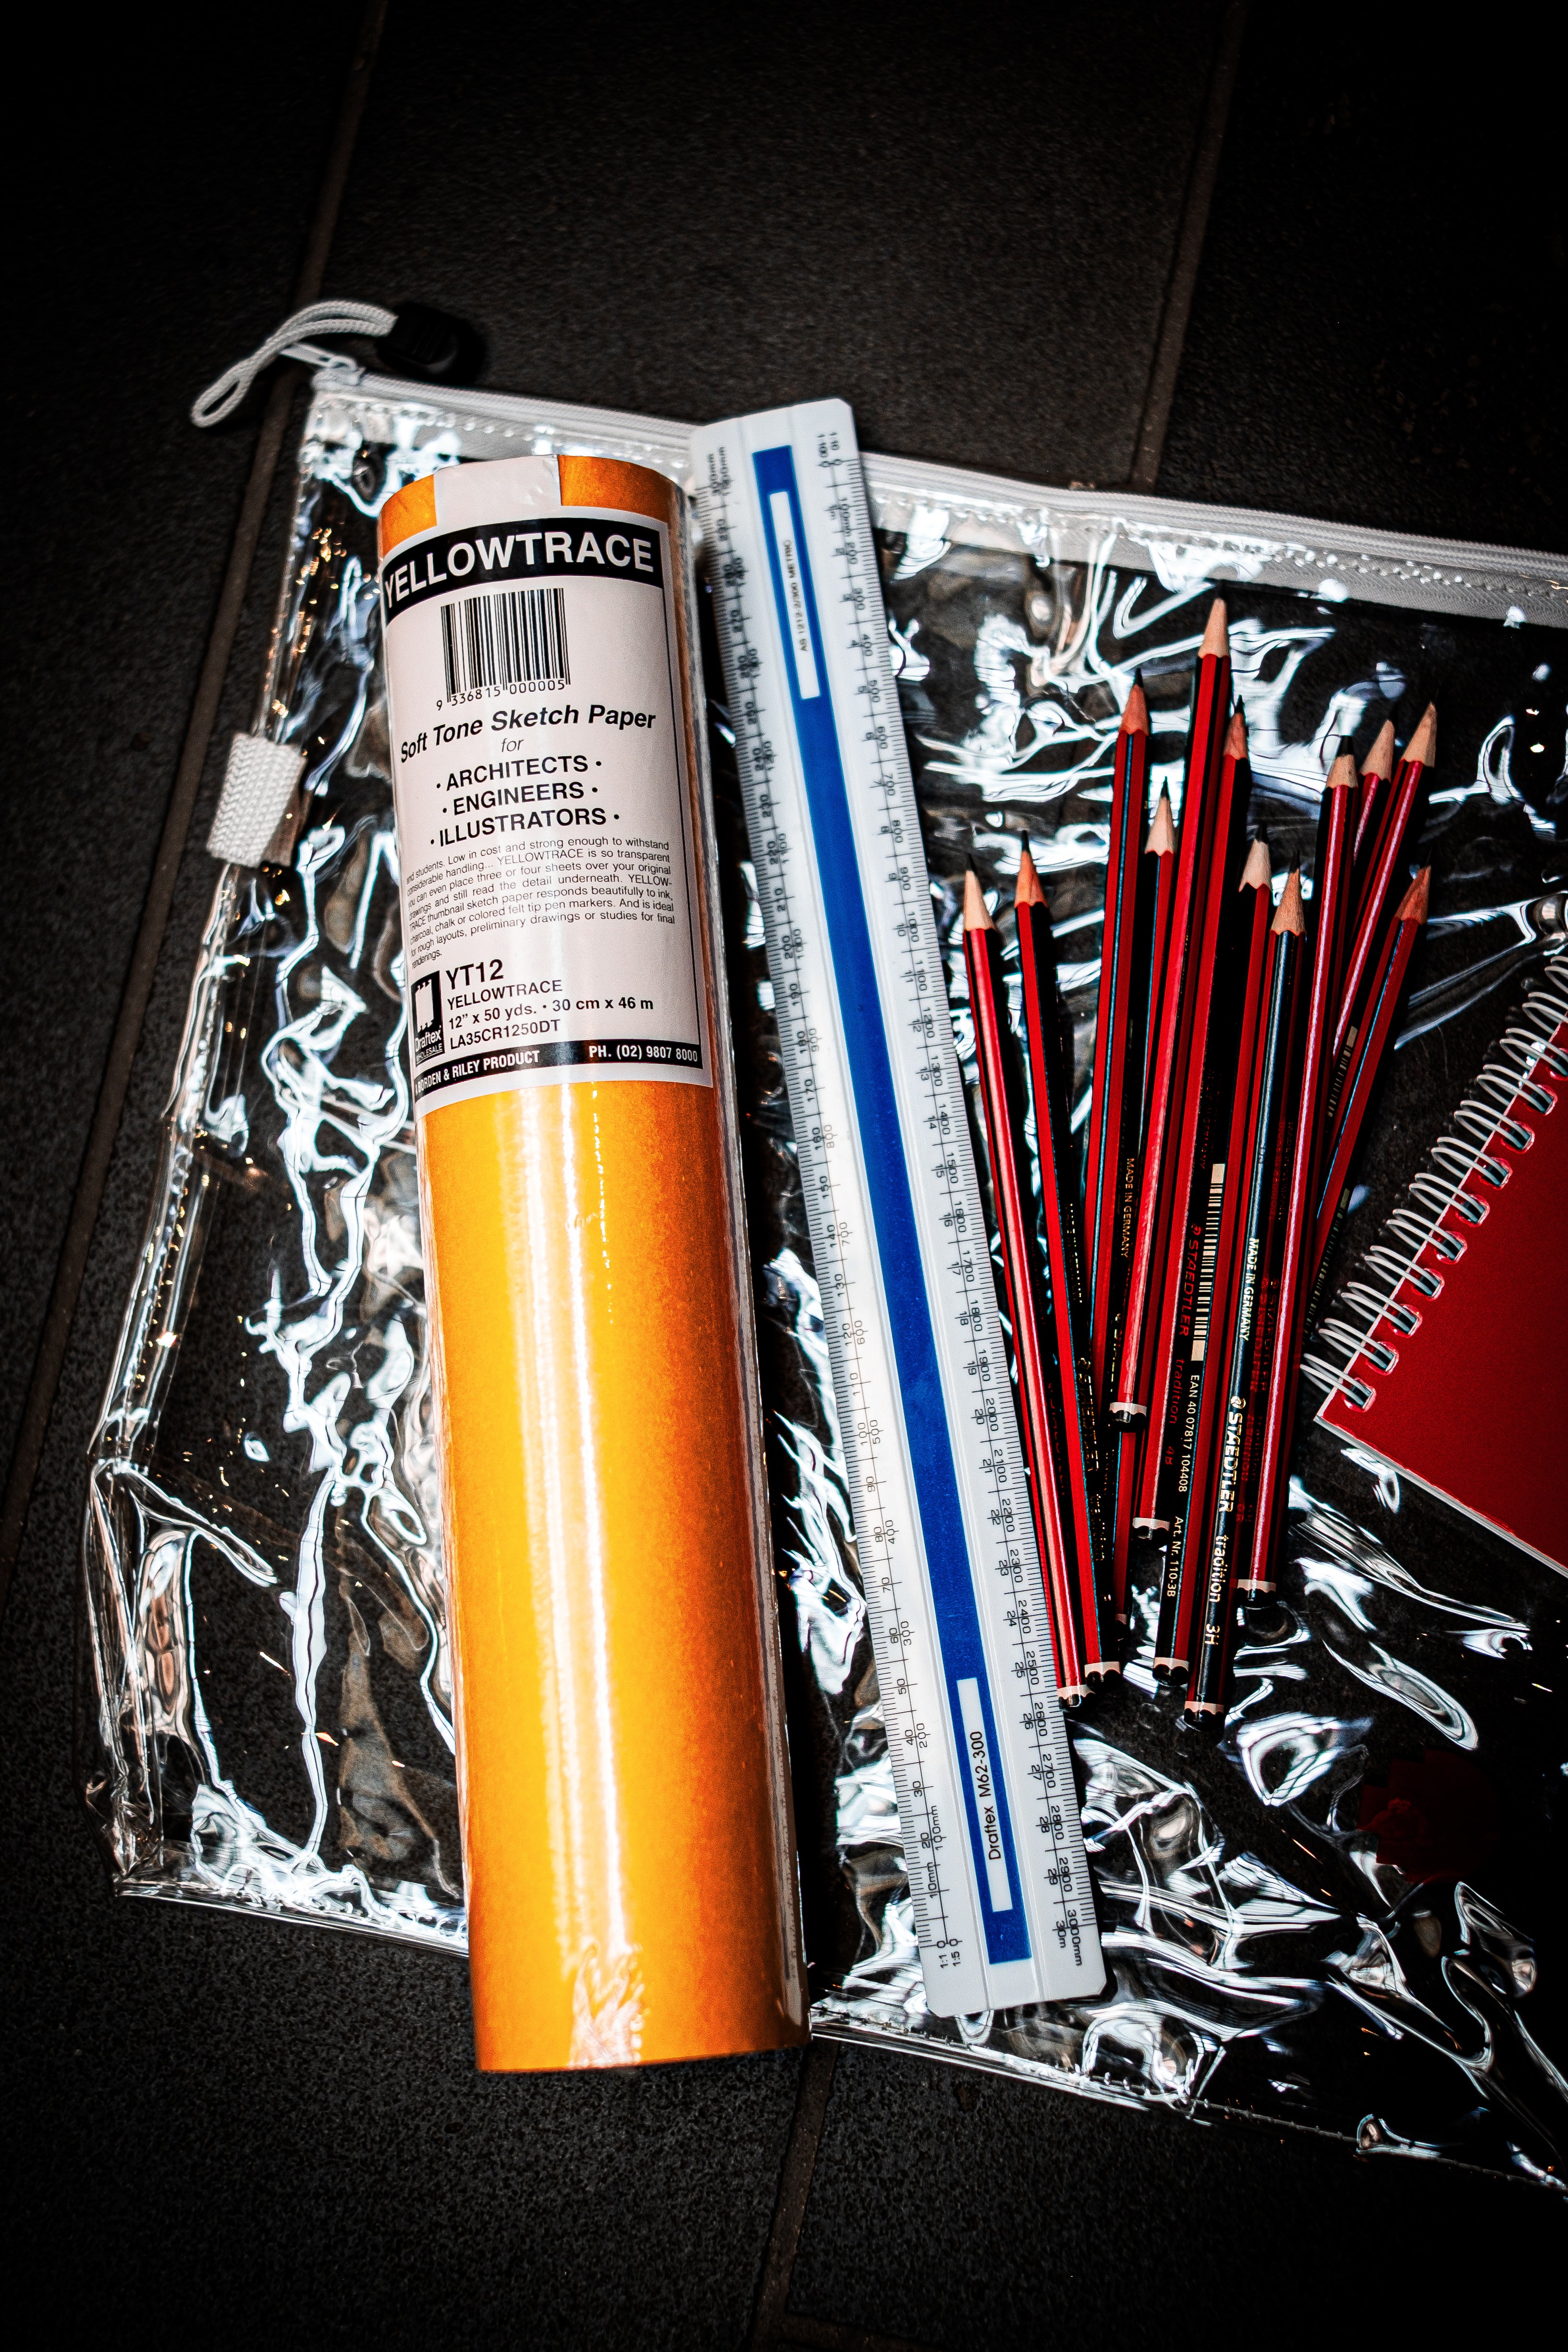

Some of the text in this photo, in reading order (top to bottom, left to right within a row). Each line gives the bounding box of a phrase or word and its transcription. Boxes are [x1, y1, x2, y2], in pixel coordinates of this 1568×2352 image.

[385, 531, 655, 609] YELLOWTRACE
[436, 679, 565, 711] 9 336815 000005
[401, 705, 656, 763] Soft Tone Sketch Paper
[501, 737, 524, 753] for
[446, 756, 588, 790] ARCHITECTS
[453, 782, 585, 815] ENGINEERS
[440, 808, 607, 847] ILLUSTRATORS
[416, 860, 445, 878] students.
[449, 855, 465, 865] Low
[469, 851, 477, 859] in
[480, 845, 501, 857] cost
[505, 842, 525, 852] and
[530, 839, 563, 849] strong
[568, 836, 608, 847] enough
[612, 837, 622, 845] to
[625, 837, 669, 850] withstand
[497, 849, 584, 865] YELLOWTRACE
[588, 848, 597, 858] is
[617, 849, 670, 863] transparent
[417, 892, 427, 903] can
[429, 884, 447, 896] even
[450, 877, 474, 892] place
[477, 871, 502, 882] three
[521, 866, 540, 875] four
[545, 862, 581, 872] sheets
[613, 863, 635, 872] your
[638, 864, 671, 875] original
[435, 895, 449, 907] and
[453, 889, 467, 901] still
[473, 883, 494, 896] read
[500, 881, 516, 890] the
[523, 876, 551, 887] detail
[559, 874, 623, 884] underneath.
[628, 874, 672, 886] YELLOW-
[409, 886, 673, 932] TRACE thumbnail sketch paper responds beautifully to ink,
[435, 919, 455, 932] chalk
[458, 916, 466, 924] or
[469, 907, 505, 921] colored
[509, 904, 524, 914] felt
[528, 903, 541, 913] tip
[545, 901, 565, 912] pen
[569, 899, 616, 908] markers.
[619, 898, 639, 908] And
[642, 899, 650, 909] is
[653, 901, 674, 912] ideal
[418, 939, 434, 953] rough
[437, 930, 467, 944] layouts,
[470, 918, 526, 937] preliminary
[530, 913, 580, 925] drawings
[600, 911, 637, 920] studies
[641, 912, 653, 921] for
[657, 913, 675, 924] final
[446, 959, 504, 990] YT12
[447, 980, 563, 1010] YELLOWTRACE
[473, 1014, 479, 1024] x
[485, 1007, 500, 1021] 50
[505, 1004, 537, 1020] yds.
[553, 999, 571, 1011] 30
[576, 998, 600, 1009] cm
[605, 1000, 613, 1009] x
[618, 997, 636, 1009] 46
[640, 1000, 653, 1009] m
[415, 1029, 441, 1052] Draftex
[450, 1019, 560, 1050] LA35CR1250DT
[416, 1043, 442, 1062] OLESALE
[417, 1045, 698, 1093] BORDEN & RILEY PRODUCT PH. (02) 9807 8000
[1121, 1158, 1134, 1258] MADE IN GERMANY
[840, 1222, 850, 1247] 700
[1179, 1239, 1199, 1336] STAEDTLER
[1239, 1238, 1259, 1340] MADE IN GERMANY
[854, 1320, 865, 1345] 600
[1169, 1359, 1185, 1423] tradition
[870, 1420, 881, 1445] 500
[1178, 1375, 1200, 1492] EAN 40 07817 104408
[1079, 1373, 1106, 1561] STAEDTLER tradition
[866, 1476, 876, 1493] 90
[875, 1526, 884, 1543] 80
[885, 1519, 895, 1545] 400
[1204, 1413, 1242, 1645] STAEDTLER tradition 3H
[1167, 1517, 1183, 1597] Art. Nr. 110-3B
[882, 1577, 892, 1593] 70
[889, 1627, 899, 1644] 60
[901, 1621, 912, 1646] 300
[1026, 1650, 1040, 1685] 2500
[897, 1678, 906, 1695] 50
[917, 1723, 928, 1748] 200
[1034, 1702, 1048, 1737] 2600
[905, 1729, 915, 1746] 40
[1042, 1753, 1056, 1788] 2700
[913, 1780, 922, 1797] 30
[969, 1730, 1002, 1861] Draftex M62-300
[930, 1805, 943, 1851] 100mm
[1051, 1805, 1064, 1840] 2800
[920, 1832, 931, 1849] 20
[926, 1862, 937, 1899] 10mm
[1059, 1857, 1073, 1892] 2900
[1056, 1921, 1066, 1948] 30m
[1068, 1909, 1082, 1966] 3000mm
[939, 1954, 948, 1969] 1:1
[951, 1951, 961, 1967] 1:5
